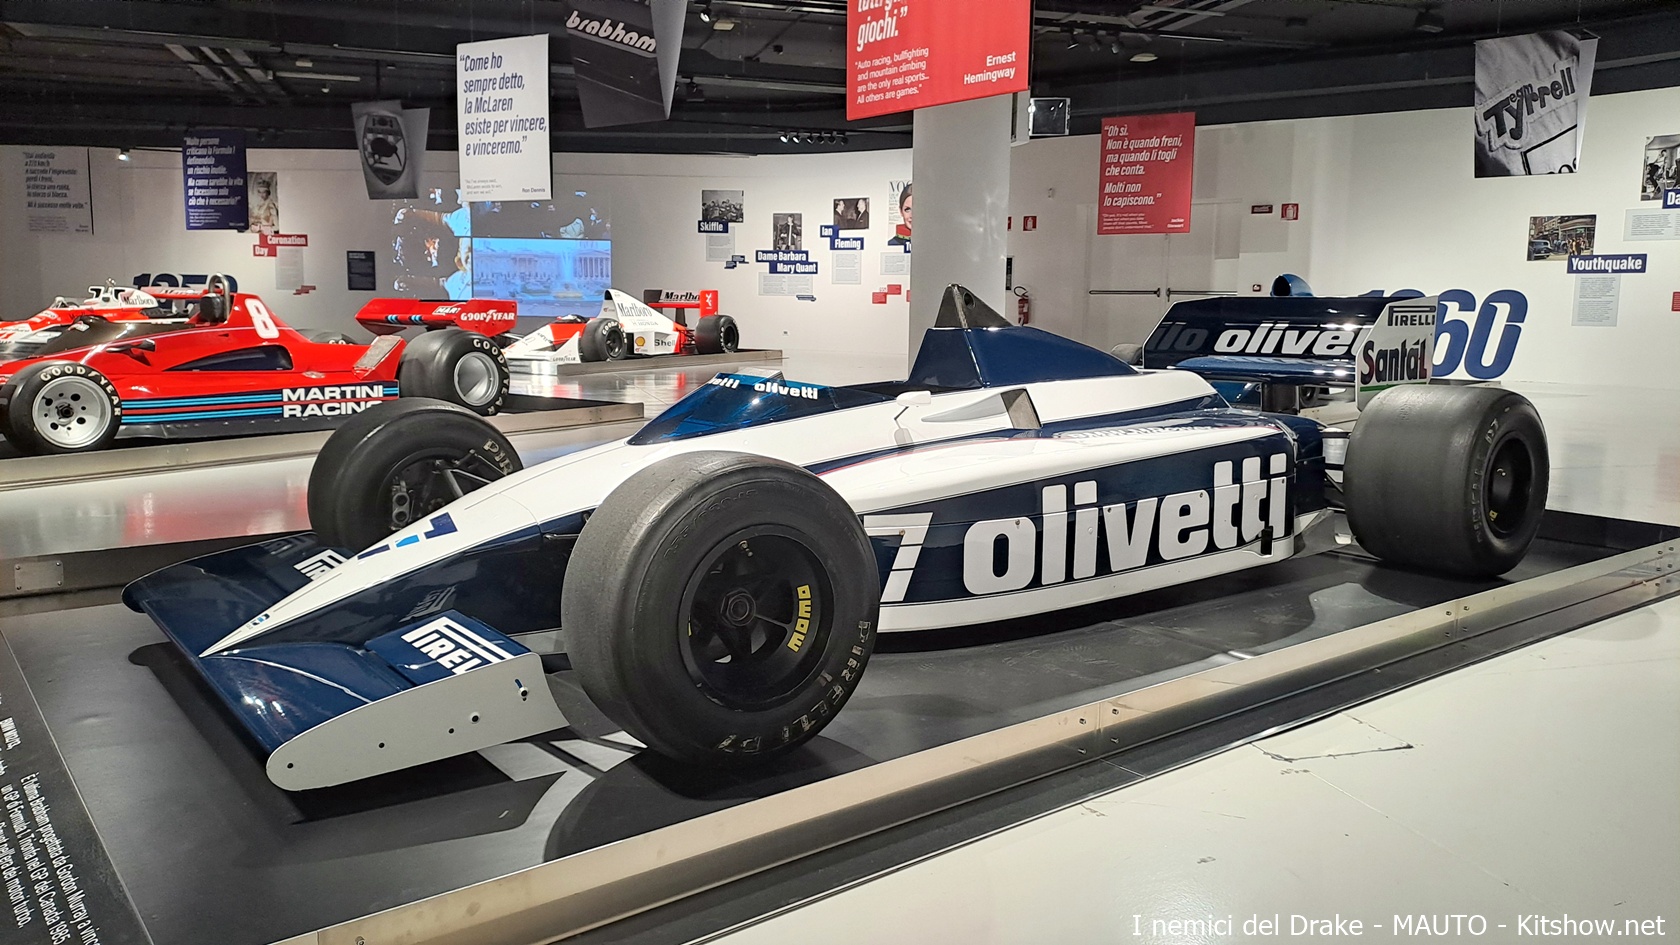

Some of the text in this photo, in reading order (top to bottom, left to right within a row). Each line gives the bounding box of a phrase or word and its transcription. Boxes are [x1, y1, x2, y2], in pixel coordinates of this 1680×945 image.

[565, 10, 657, 52] brabham
[459, 51, 503, 73] “Come ho
[872, 55, 892, 66] racing,
[893, 47, 929, 62] bullfighting
[986, 51, 1017, 67] Ernest
[857, 60, 927, 82] and mountain climbing
[963, 67, 1016, 85] Hemingway
[463, 72, 525, 96] sempre detto,
[857, 84, 867, 93] are
[867, 81, 878, 91] the
[878, 78, 892, 90] only
[892, 75, 905, 86] real
[464, 96, 513, 115] la McLaren
[856, 94, 865, 105] All
[865, 92, 884, 103] others
[885, 91, 896, 99] are
[1483, 67, 1575, 140] Tyrrell
[465, 115, 547, 137] esiste per vincere,
[465, 135, 528, 157] e vinceremo.”
[1106, 134, 1183, 152] Non è quando freni,
[1105, 148, 1178, 165] ma quando li togli
[1105, 164, 1146, 176] che conta.
[1104, 181, 1141, 194] Molti non
[1103, 195, 1112, 207] lo
[700, 221, 724, 232] Skiffle
[821, 226, 833, 236] Ian
[267, 235, 306, 245] Coronation
[834, 239, 861, 250] Fleming
[254, 246, 269, 257] Day
[758, 250, 807, 261] Dame Barbara
[777, 262, 817, 274] Mary Quant
[1571, 256, 1643, 274] Youthquake
[123, 294, 155, 306] Marlboro
[246, 297, 281, 339] 8
[460, 309, 515, 323] GOODYEAR
[617, 302, 653, 317] Marlboro
[1387, 305, 1436, 327] PIRELLI
[654, 338, 676, 347] Shell
[40, 365, 121, 416] GOODYEAR
[282, 385, 384, 402] MARTINI
[754, 381, 819, 400] olivetti
[963, 452, 1288, 595] olivetti
[864, 511, 934, 602] 7
[787, 584, 812, 652] momo
[3, 790, 20, 802] GP
[29, 796, 50, 828] Brabham
[19, 833, 41, 861] Trionfa
[36, 823, 65, 859] progettata
[25, 857, 46, 872] nel
[52, 855, 70, 869] da
[2, 866, 22, 882] dei
[30, 867, 49, 882] GP
[56, 863, 79, 896] Gordon
[5, 877, 31, 906] motori
[34, 880, 55, 896] del
[12, 899, 35, 929] turbo.
[38, 891, 65, 926] Canada
[67, 889, 89, 924] Murray
[48, 920, 71, 945] 1985
[77, 919, 92, 930] a
[79, 925, 101, 945] vinc
